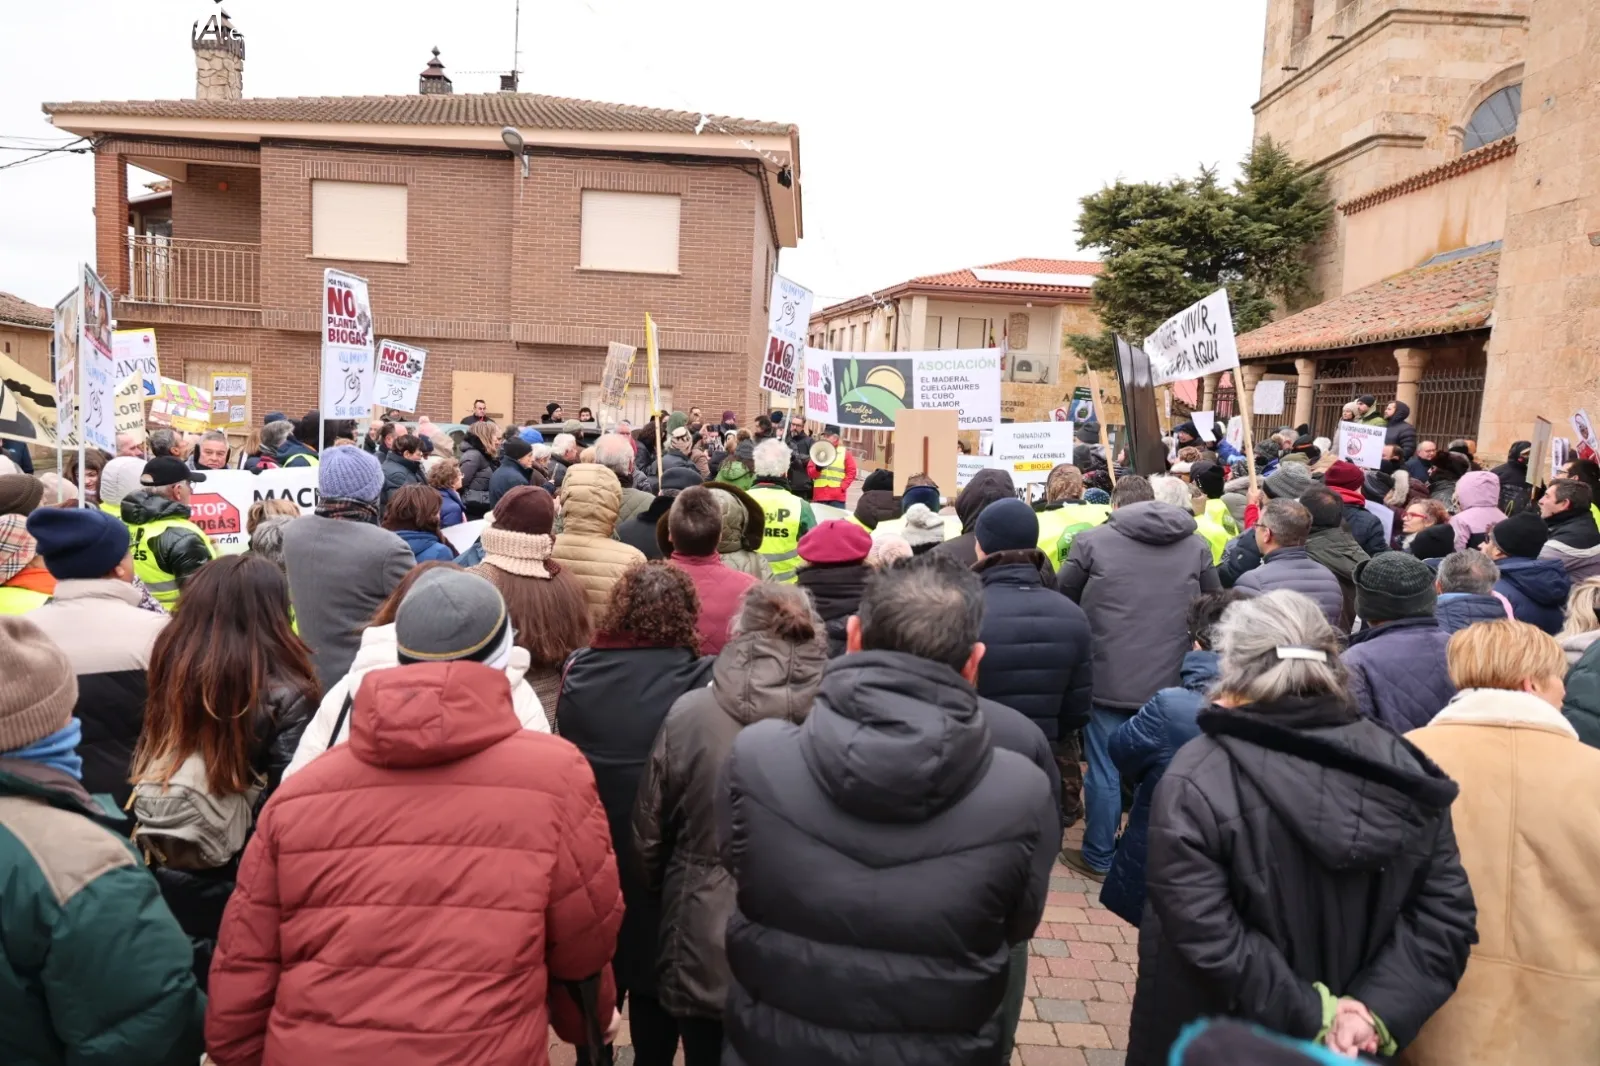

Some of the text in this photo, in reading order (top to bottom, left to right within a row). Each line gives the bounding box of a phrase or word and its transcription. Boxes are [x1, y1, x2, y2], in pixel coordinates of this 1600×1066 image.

[327, 287, 356, 318] NO
[328, 316, 357, 329] PLANTA
[328, 328, 367, 346] BIOGAS
[381, 347, 408, 364] NO
[768, 336, 795, 370] NO
[380, 364, 412, 378] BIOGAS
[381, 360, 405, 370] PLANTA
[917, 357, 996, 371] ASOCIACIÓN
[765, 363, 794, 385] OLORES
[808, 368, 820, 388] STOP
[921, 383, 980, 391] CUELGAMURES
[844, 404, 873, 415] Pueblos
[859, 414, 884, 424] Sanos
[1030, 462, 1053, 470] BIOGAS
[764, 528, 789, 538] RES
